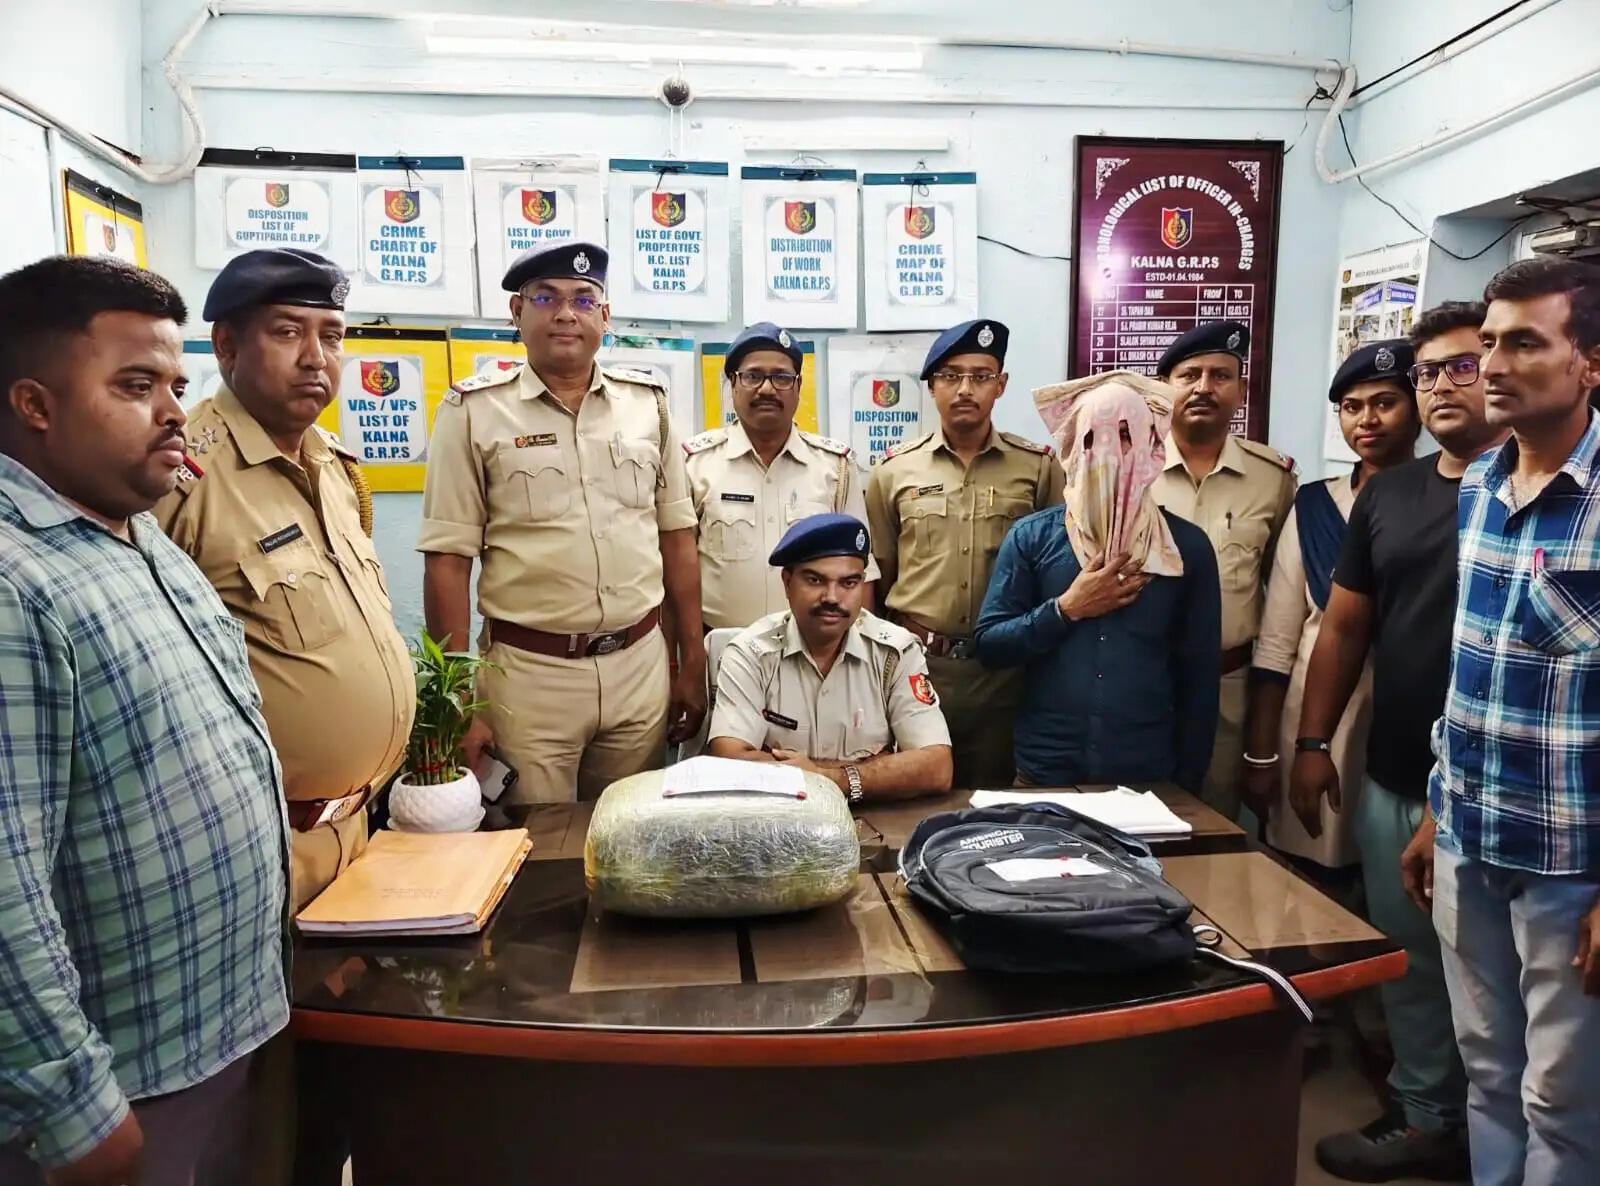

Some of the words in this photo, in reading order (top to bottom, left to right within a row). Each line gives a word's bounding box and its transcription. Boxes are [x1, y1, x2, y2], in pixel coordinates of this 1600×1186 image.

[1140, 176, 1166, 196] LIST
[1168, 175, 1184, 188] OF
[1186, 176, 1234, 207] OFFICER
[248, 210, 308, 220] DISPOSITION
[262, 221, 281, 230] LIST
[283, 222, 295, 231] OF
[380, 225, 425, 238] CRIME
[236, 230, 288, 242] GUPTIPARA
[508, 228, 528, 237] LIST
[531, 228, 544, 238] OF
[636, 229, 657, 239] LIST
[660, 230, 672, 240] OF
[370, 240, 418, 253] CHART
[420, 242, 438, 254] OF
[638, 242, 700, 254] PROPERTIES
[771, 238, 832, 254] DISTRIBUTION
[898, 244, 944, 255] CRIME
[382, 254, 426, 268] KALNA
[648, 256, 668, 266] H.C.
[670, 256, 690, 266] LIST
[782, 258, 793, 270] OF
[794, 258, 821, 272] WORK
[896, 258, 926, 268] MAP
[930, 258, 946, 269] OF
[1131, 256, 1174, 268] KALNA
[1177, 256, 1220, 269] G.R.P.S
[382, 269, 427, 283] G.R.P.S
[653, 268, 686, 278] KALNA
[899, 272, 944, 282] KALNA
[653, 280, 686, 291] G.R.P.S
[774, 276, 800, 290] KALNA
[802, 277, 830, 290] G.R.P.S
[900, 286, 944, 296] G.R.P.S
[1146, 288, 1164, 300] NAME
[1204, 288, 1222, 299] FROM
[1234, 289, 1243, 299] TO
[348, 399, 376, 411] VAs
[390, 399, 416, 411] VPs
[359, 414, 388, 427] LIST
[392, 415, 410, 428] OF
[854, 410, 918, 422] DISPOSITION
[363, 430, 408, 443] KALNA
[869, 425, 890, 436] LIST
[892, 425, 904, 437] OF
[364, 446, 410, 459] G.R.P.S
[960, 830, 1020, 846] AMERICAN
[961, 832, 1024, 850] TOURISTER
